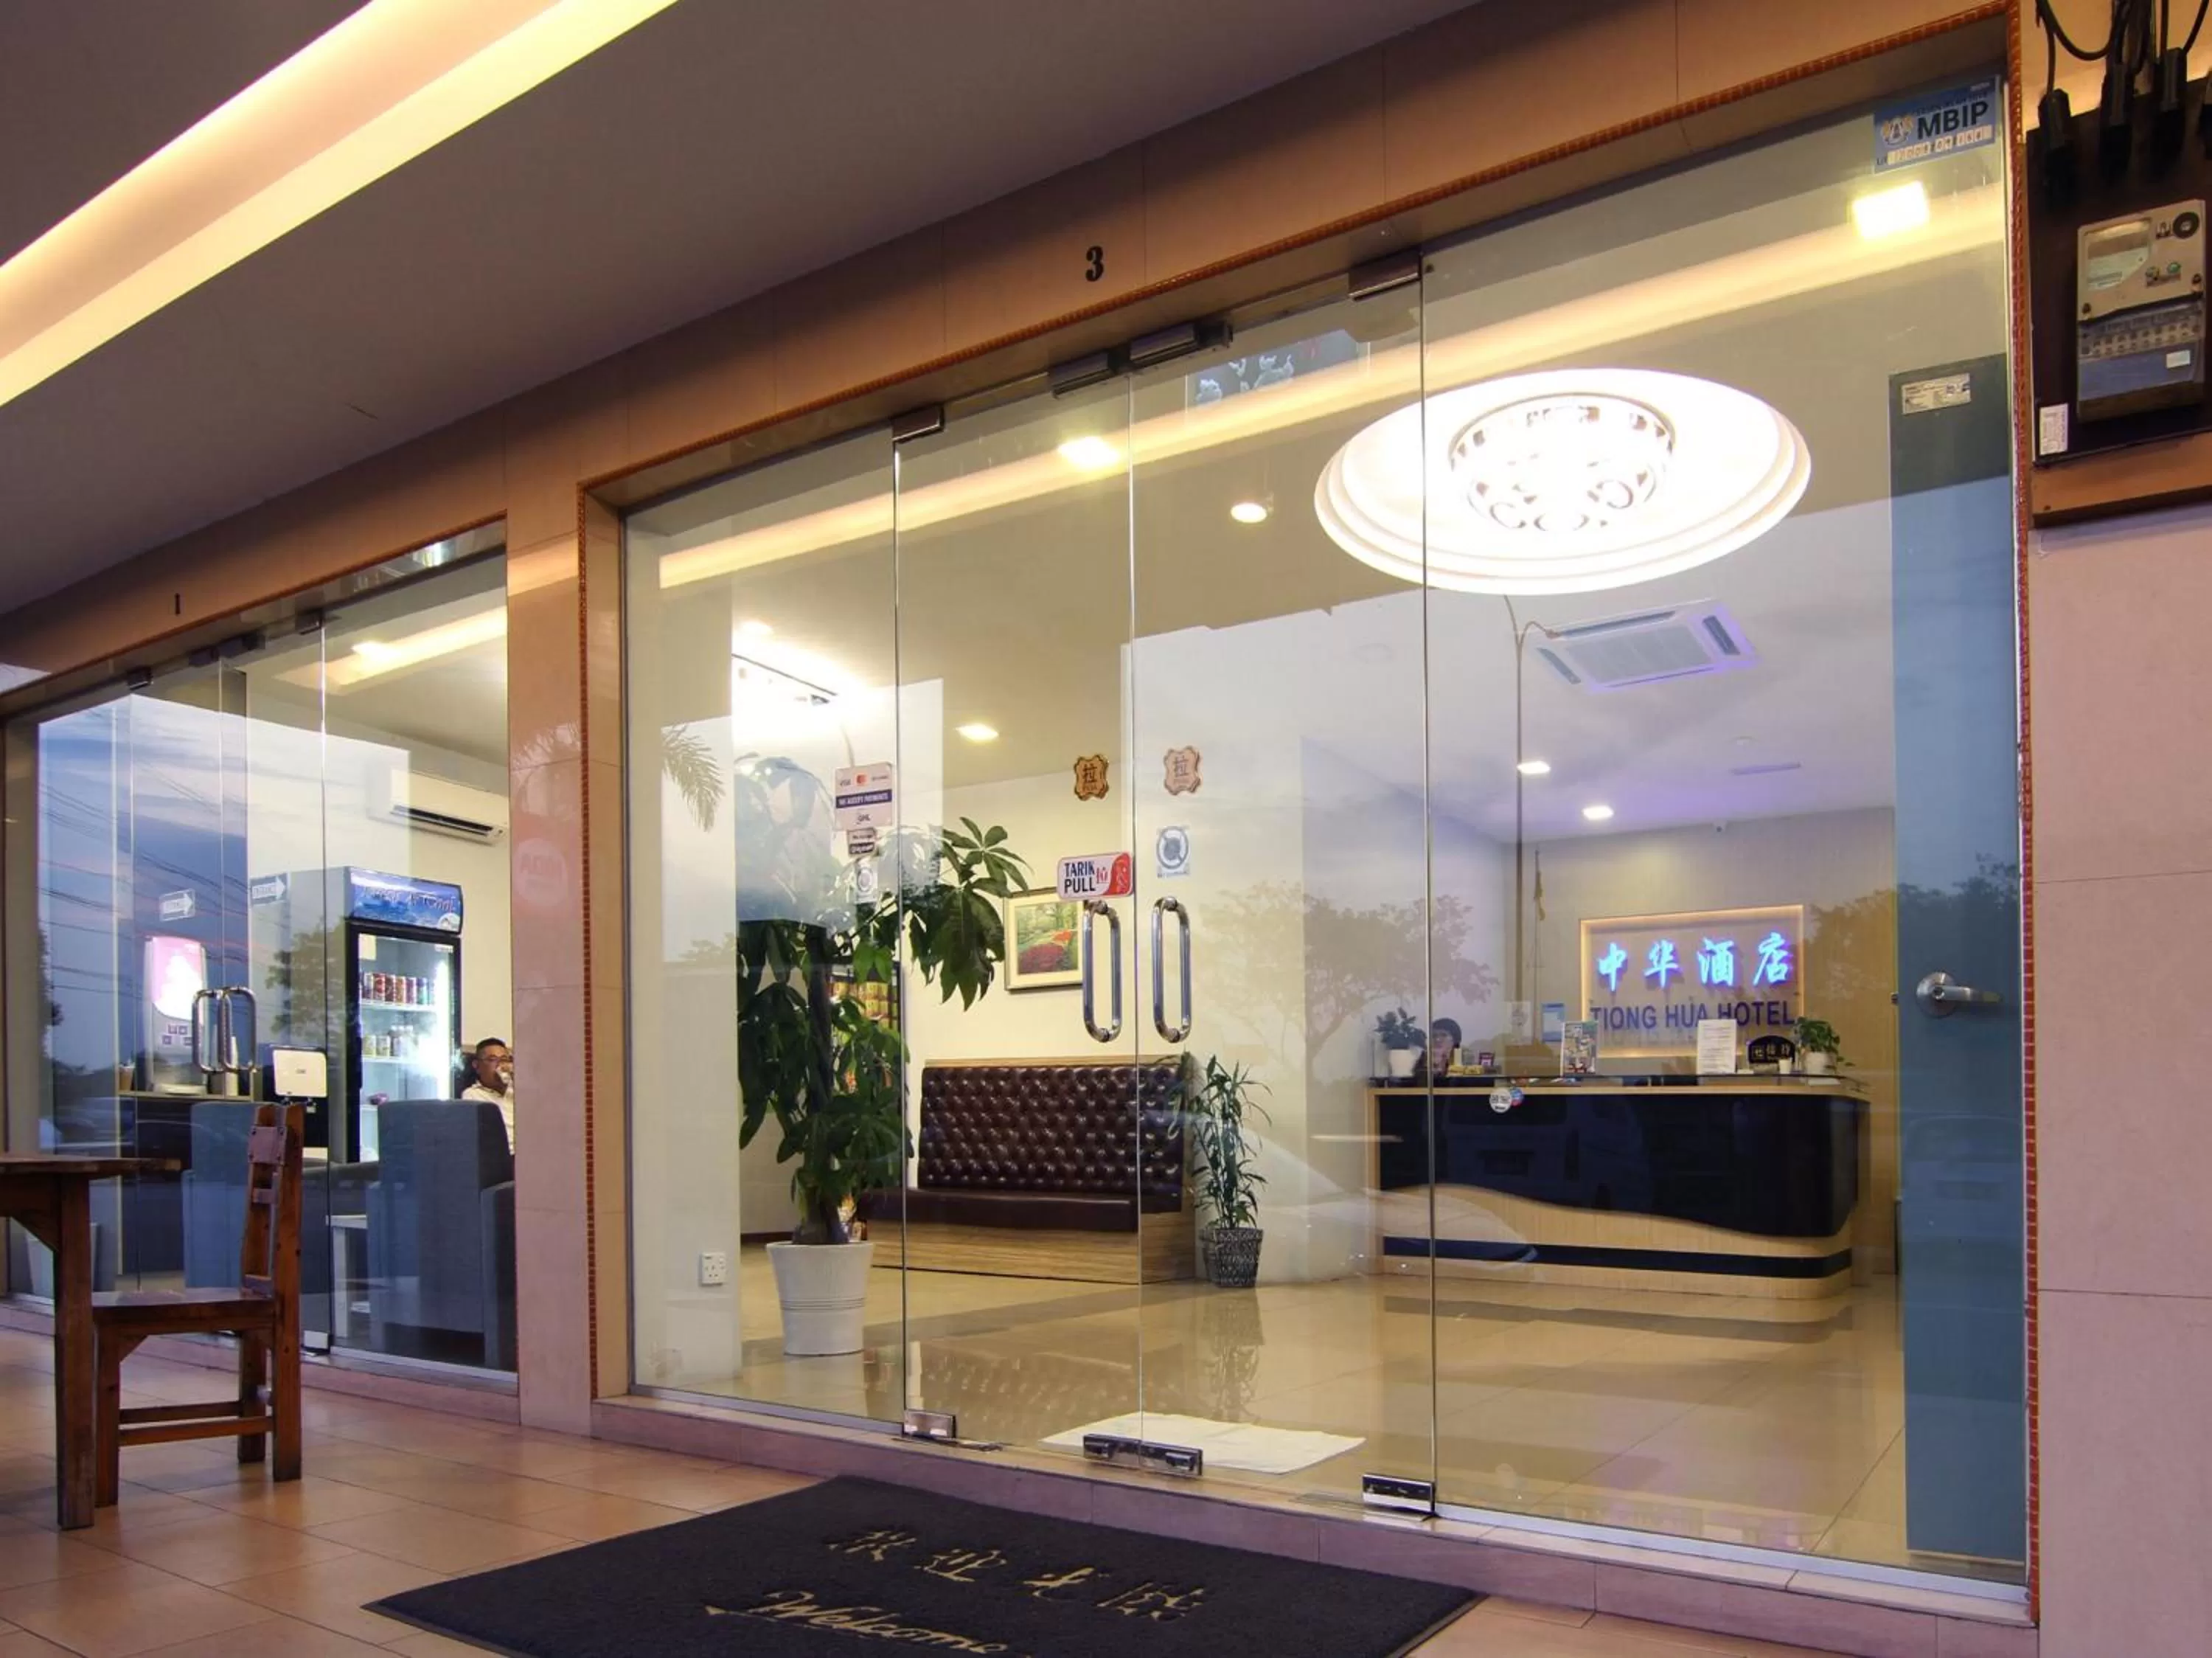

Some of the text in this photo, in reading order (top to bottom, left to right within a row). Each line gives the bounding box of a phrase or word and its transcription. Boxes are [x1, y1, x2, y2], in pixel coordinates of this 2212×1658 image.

[1918, 101, 1989, 140] MBIP
[1085, 245, 1104, 282] 3
[1064, 861, 1095, 878] TARIK
[1064, 876, 1096, 894] PULL
[1597, 932, 1790, 992] 中华酒店
[1590, 1000, 1795, 1030] TIONG HUA HOTEL
[747, 1591, 1009, 1654] Welcome
